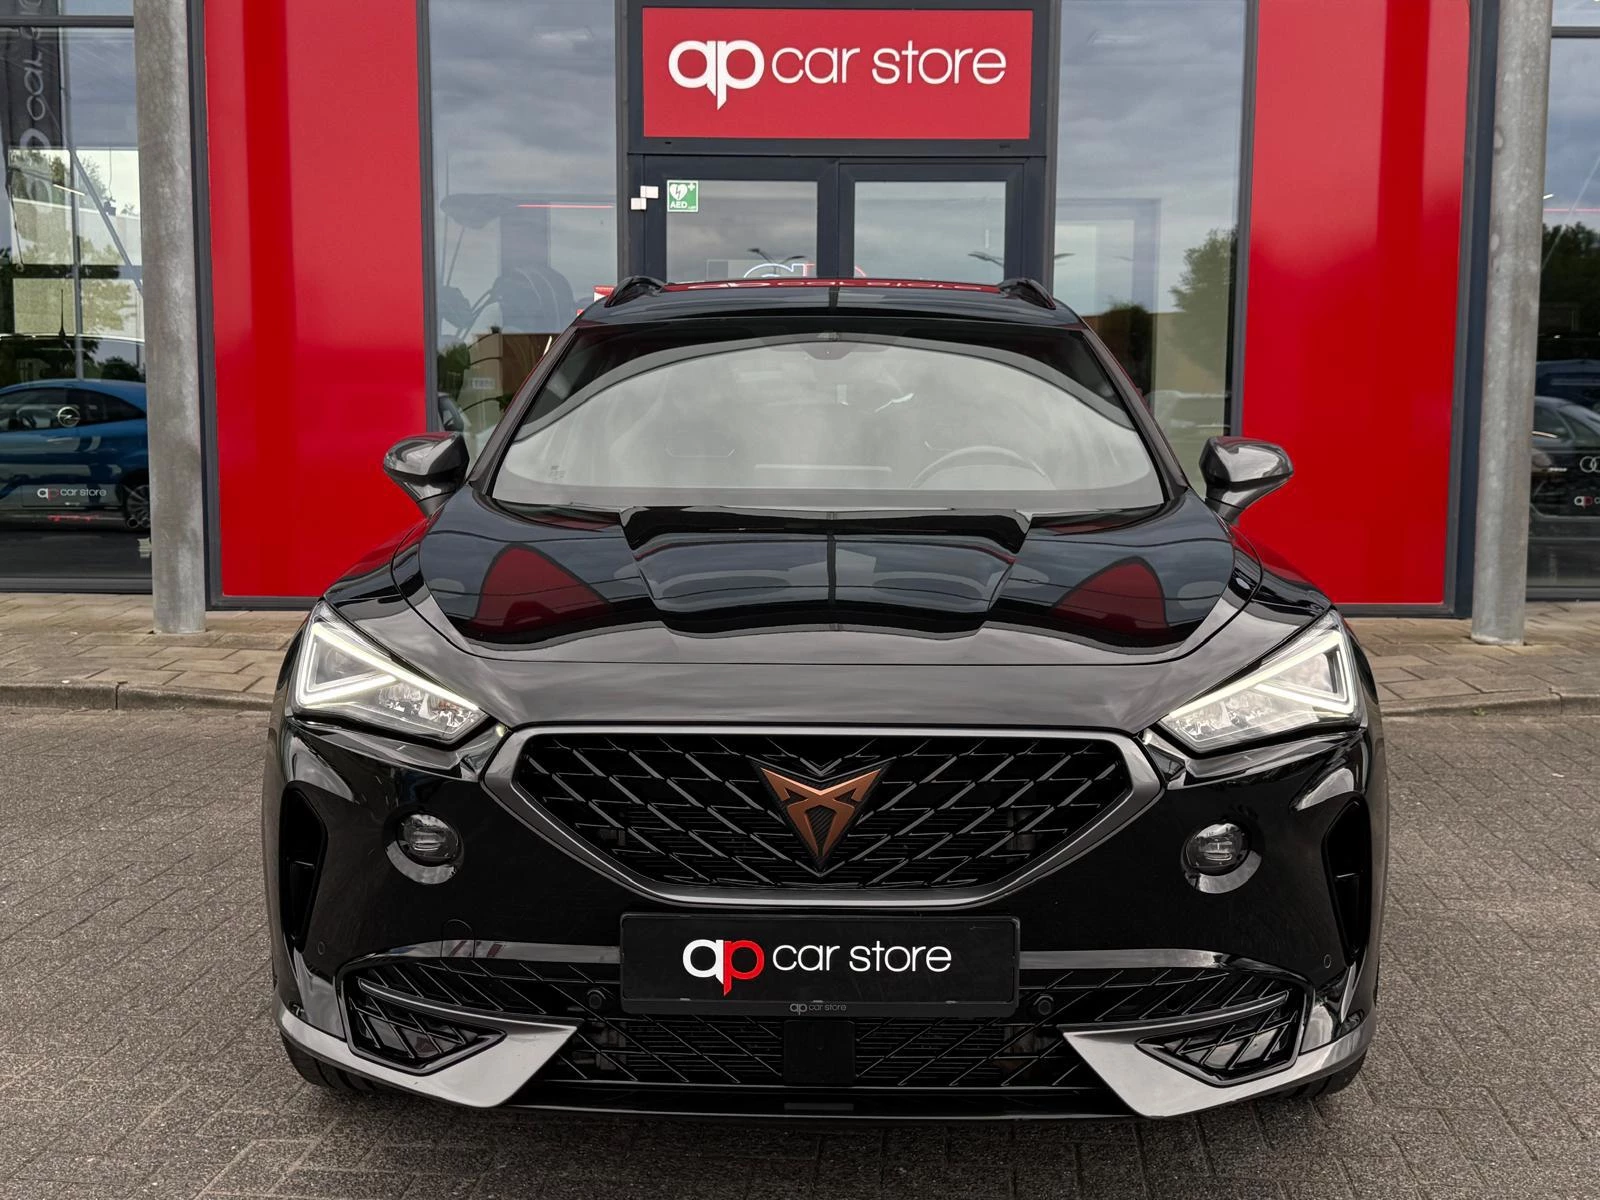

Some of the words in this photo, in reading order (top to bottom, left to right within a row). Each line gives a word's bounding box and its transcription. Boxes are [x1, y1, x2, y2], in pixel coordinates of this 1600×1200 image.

[771, 46, 860, 85] car
[871, 40, 1007, 85] store
[669, 200, 689, 209] AED
[60, 488, 78, 497] car
[79, 487, 107, 497] store
[682, 938, 765, 996] ap
[772, 944, 840, 972] car
[849, 940, 952, 973] store
